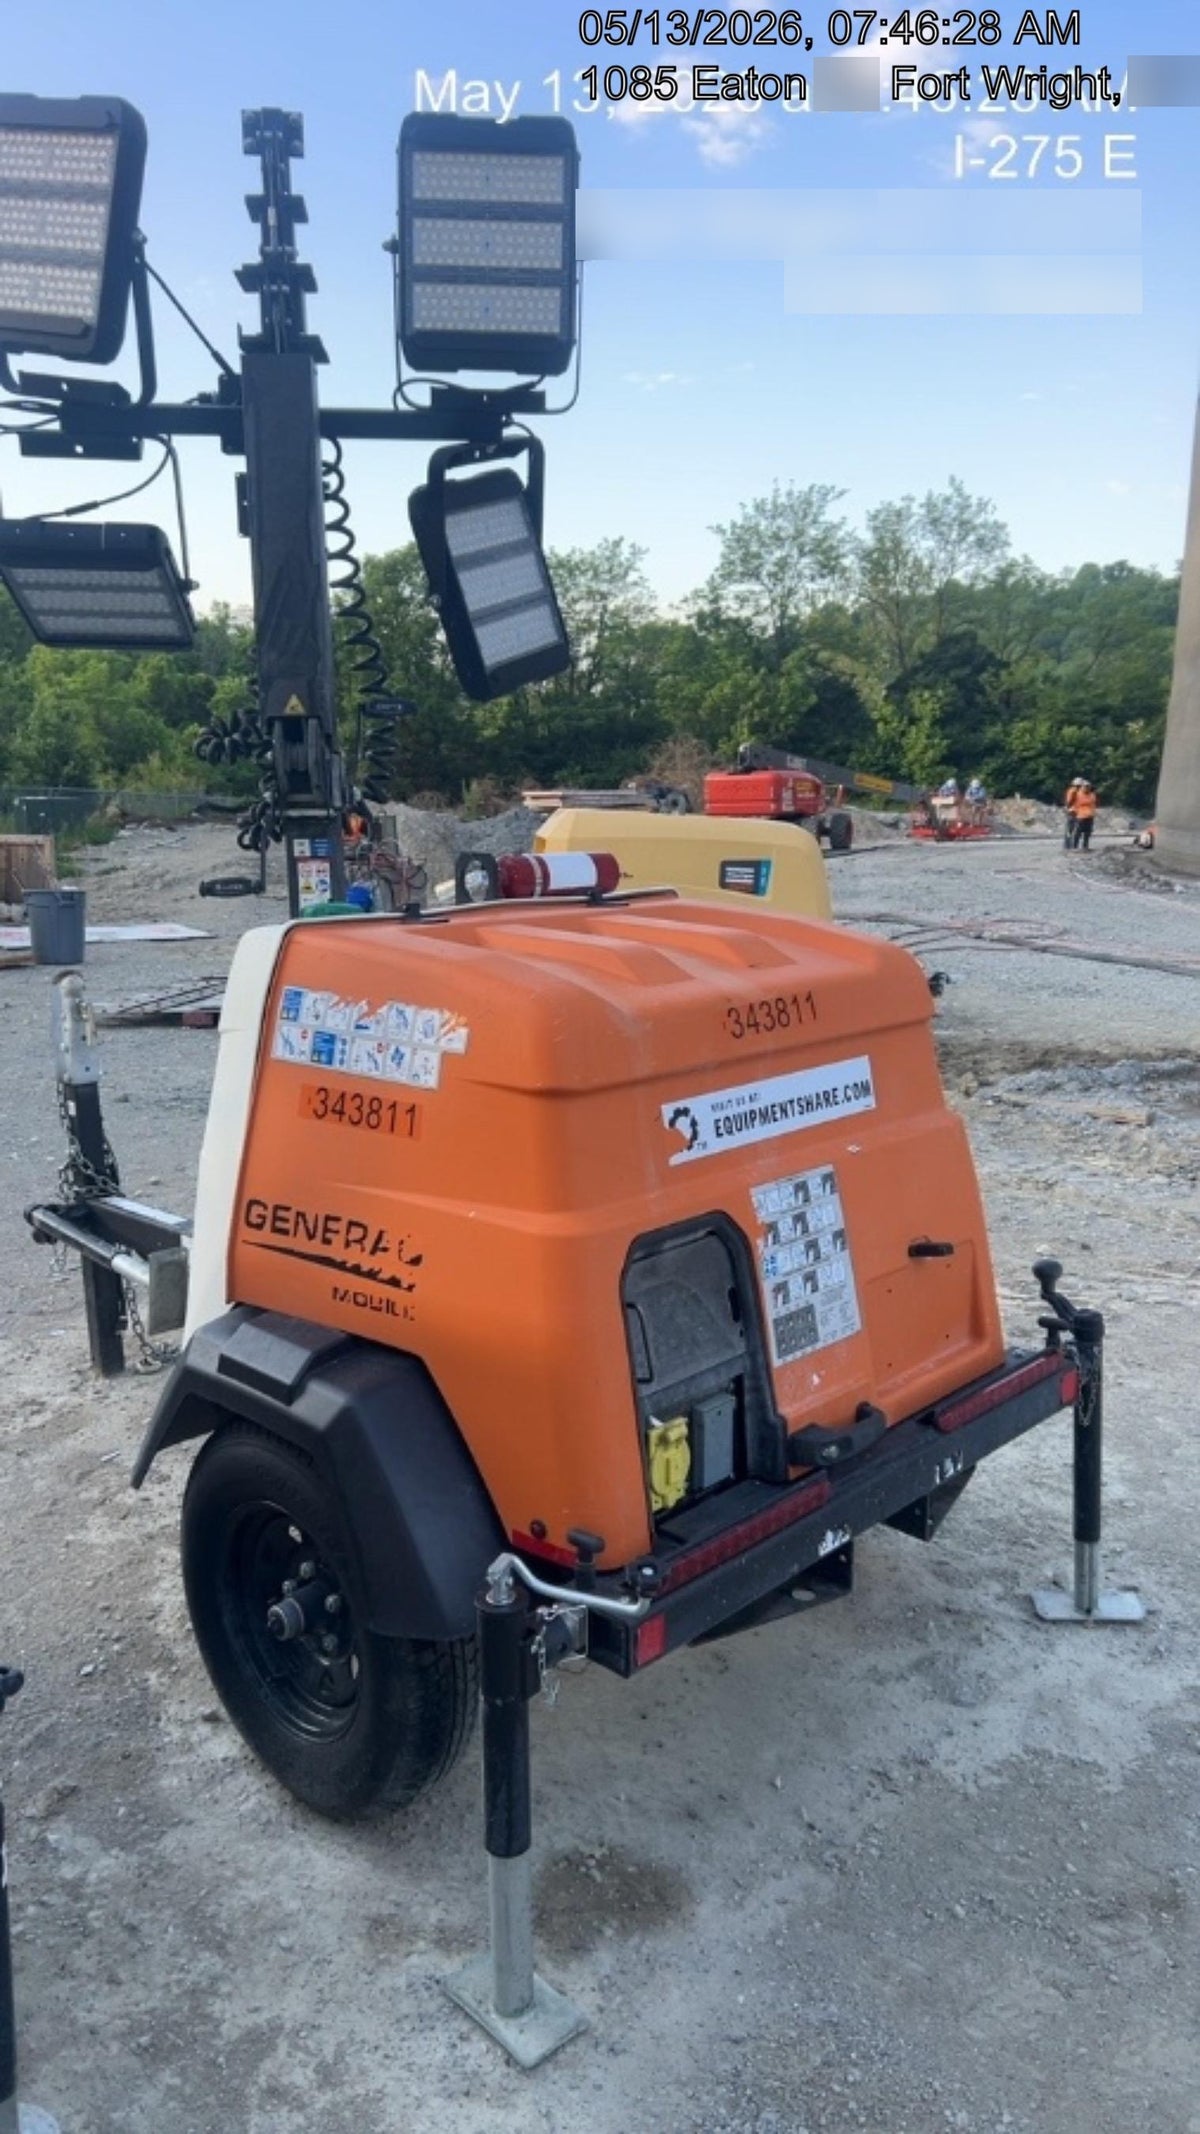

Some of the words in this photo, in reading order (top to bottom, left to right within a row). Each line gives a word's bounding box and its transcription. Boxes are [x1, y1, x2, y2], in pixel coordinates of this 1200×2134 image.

[725, 990, 818, 1039] 343811
[312, 1087, 418, 1138] 343811
[713, 1079, 872, 1139] EQUIPMENTSHARE.COM
